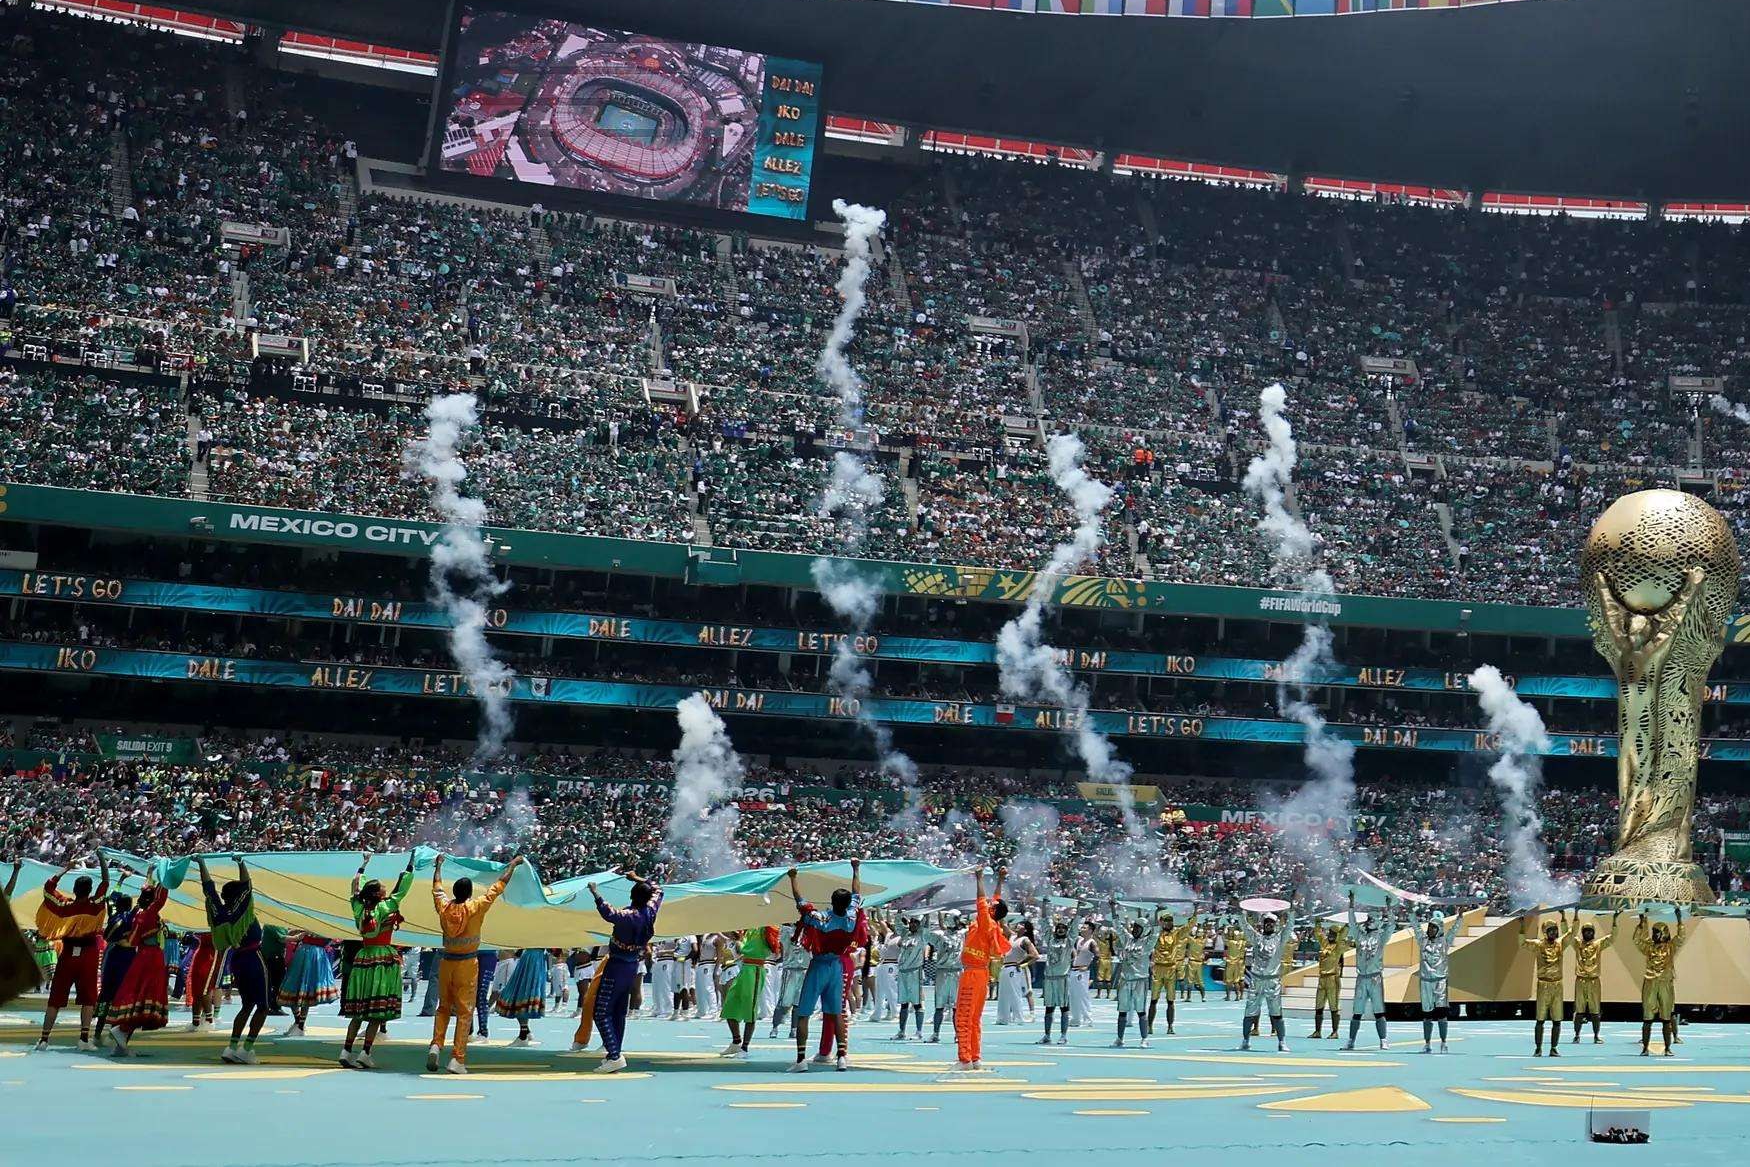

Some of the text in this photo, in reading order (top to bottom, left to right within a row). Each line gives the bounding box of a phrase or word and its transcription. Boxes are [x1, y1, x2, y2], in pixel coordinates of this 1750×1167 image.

[777, 105, 800, 120] IKO
[764, 156, 802, 174] ALLEZ
[229, 513, 440, 546] MEXICO CITY
[1260, 597, 1342, 617] #FIFAWorldCup
[22, 573, 87, 598] LET'S
[92, 579, 122, 600] GO
[332, 597, 364, 617] DAI
[370, 601, 402, 622] DAI
[481, 608, 508, 628] KO
[589, 618, 632, 638] DALE
[698, 625, 754, 647] ALLEZ
[854, 634, 878, 654] GO
[1081, 651, 1107, 669] DAI
[1166, 655, 1195, 674] IKO
[1358, 667, 1405, 687] ALLEZ
[1702, 685, 1727, 702] DAI
[56, 647, 96, 670] IKO
[187, 658, 236, 680] DALE
[311, 666, 374, 690] ALLEZ
[736, 692, 764, 712] DAI
[829, 696, 860, 717] IKO
[934, 703, 973, 724] DALE
[1128, 715, 1176, 736] LET'S
[1180, 717, 1203, 737] GO
[1363, 726, 1388, 746] DAI
[1393, 729, 1418, 748] DAI
[1569, 737, 1605, 756] DALE
[116, 740, 146, 752] SALIDA
[147, 741, 166, 753] EXIT
